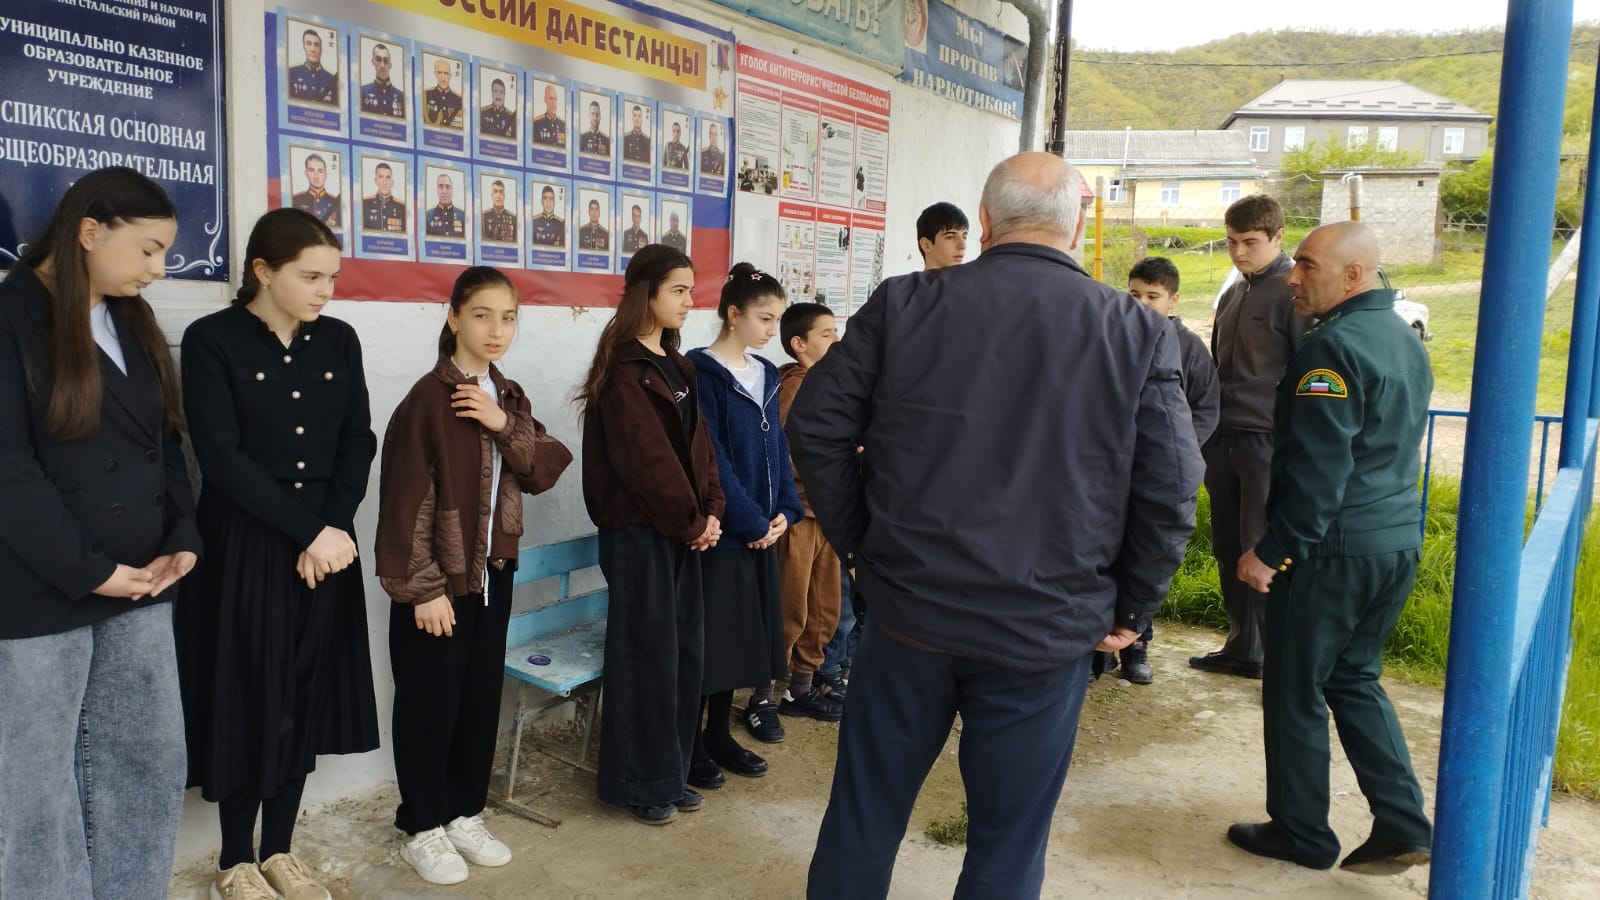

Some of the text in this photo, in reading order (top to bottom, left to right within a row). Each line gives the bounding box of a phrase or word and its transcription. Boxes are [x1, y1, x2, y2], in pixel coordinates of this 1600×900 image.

[79, 0, 140, 20] СТАЛЬСКИЙ
[142, 12, 176, 28] РАЙОН
[150, 1, 158, 11] И
[160, 3, 194, 19] НАУКИ
[195, 11, 207, 24] РД
[128, 43, 204, 71] КАЗЕННОЕ
[545, 7, 700, 77] ДАГЕСТАНЦЫ
[23, 43, 174, 84] ОБРАЗОВАТЕЛЬНОЕ
[740, 53, 768, 73] УГОЛОК
[769, 61, 849, 97] АНТИТЕРРОРИСТИЧЕСКОЙ
[848, 87, 889, 110] БЕЗОПАСНОСТИ
[939, 43, 998, 82] ПРОТИВ
[48, 68, 154, 100] УЧРЕЖДЕНИЕ
[912, 66, 1018, 120] НАРКОТИКОВ!
[1, 99, 206, 151] СПИКСКАЯ ОСНОВНАЯ
